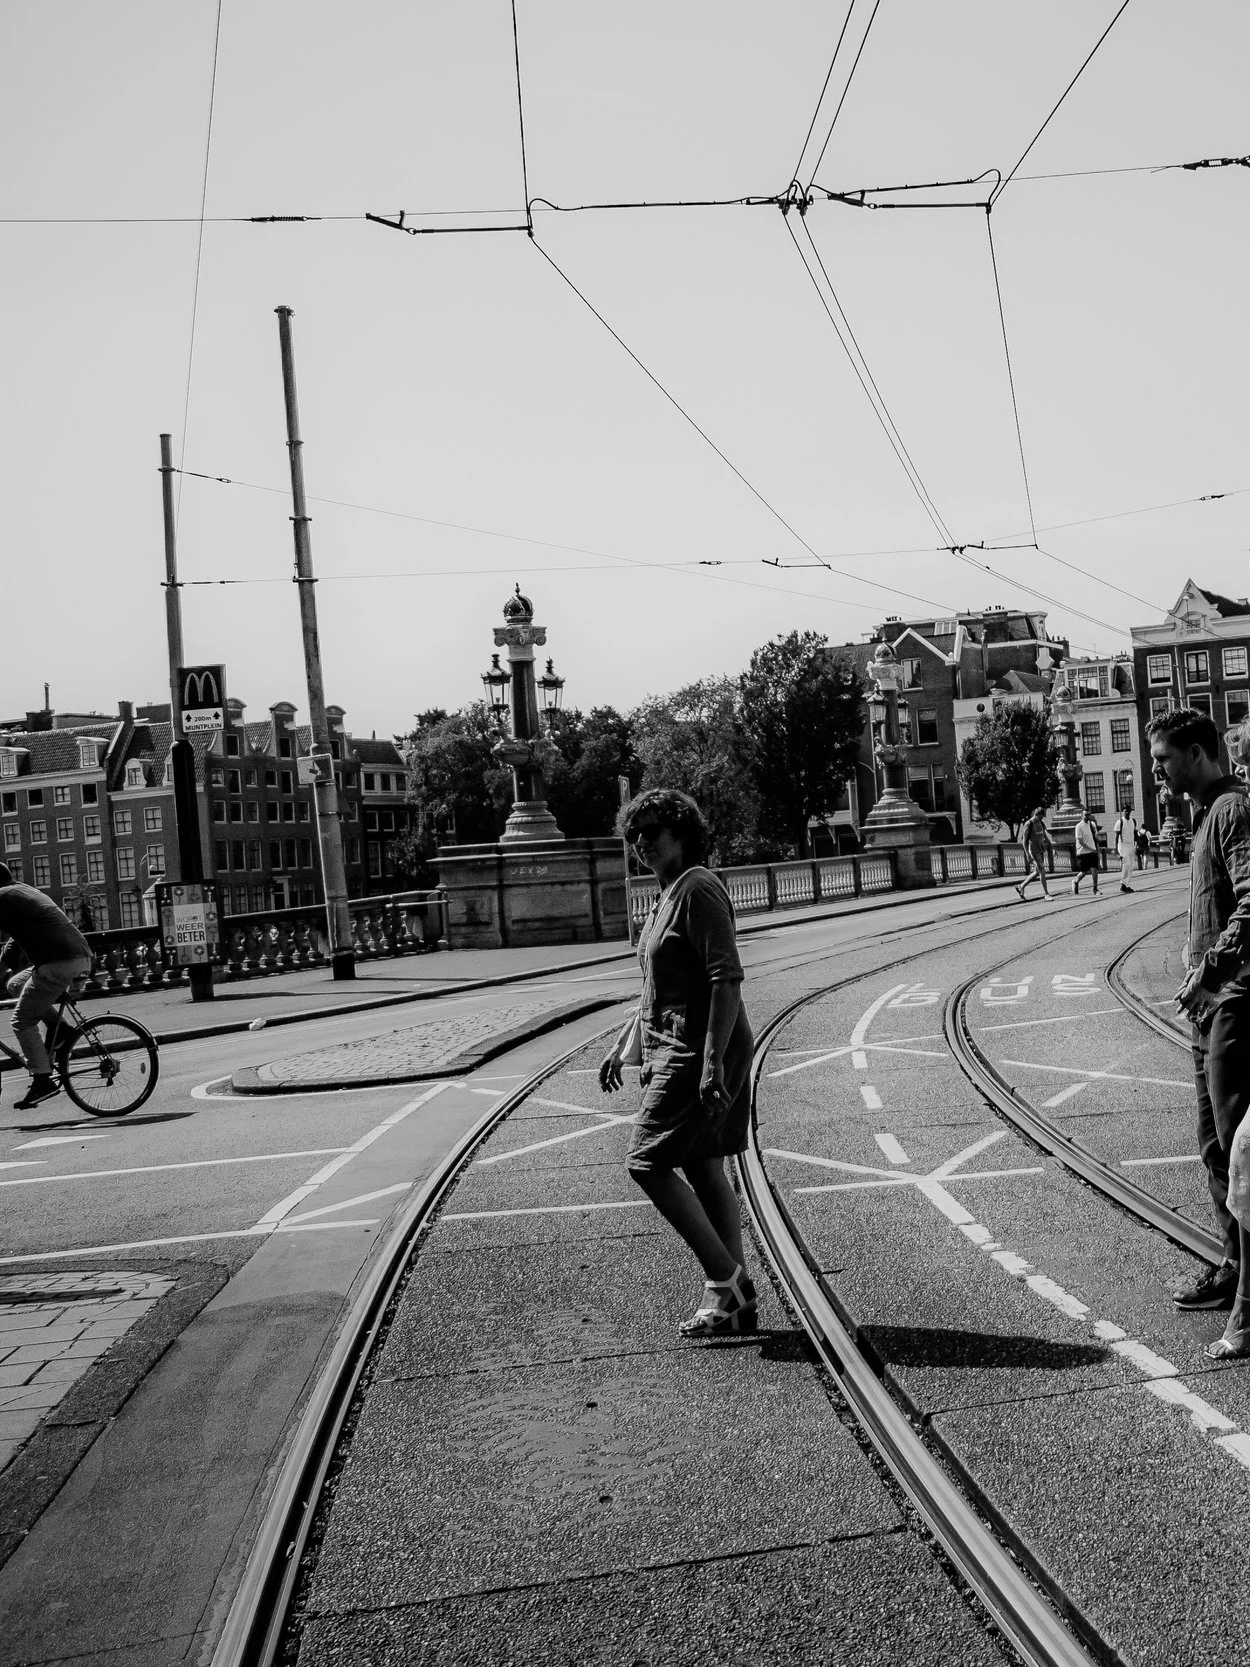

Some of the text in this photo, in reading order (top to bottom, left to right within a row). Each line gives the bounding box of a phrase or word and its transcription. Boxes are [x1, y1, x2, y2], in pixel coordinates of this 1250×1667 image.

[185, 722, 222, 731] MUNTPLEIN
[177, 922, 204, 931] WEER
[178, 931, 205, 943] BETER
